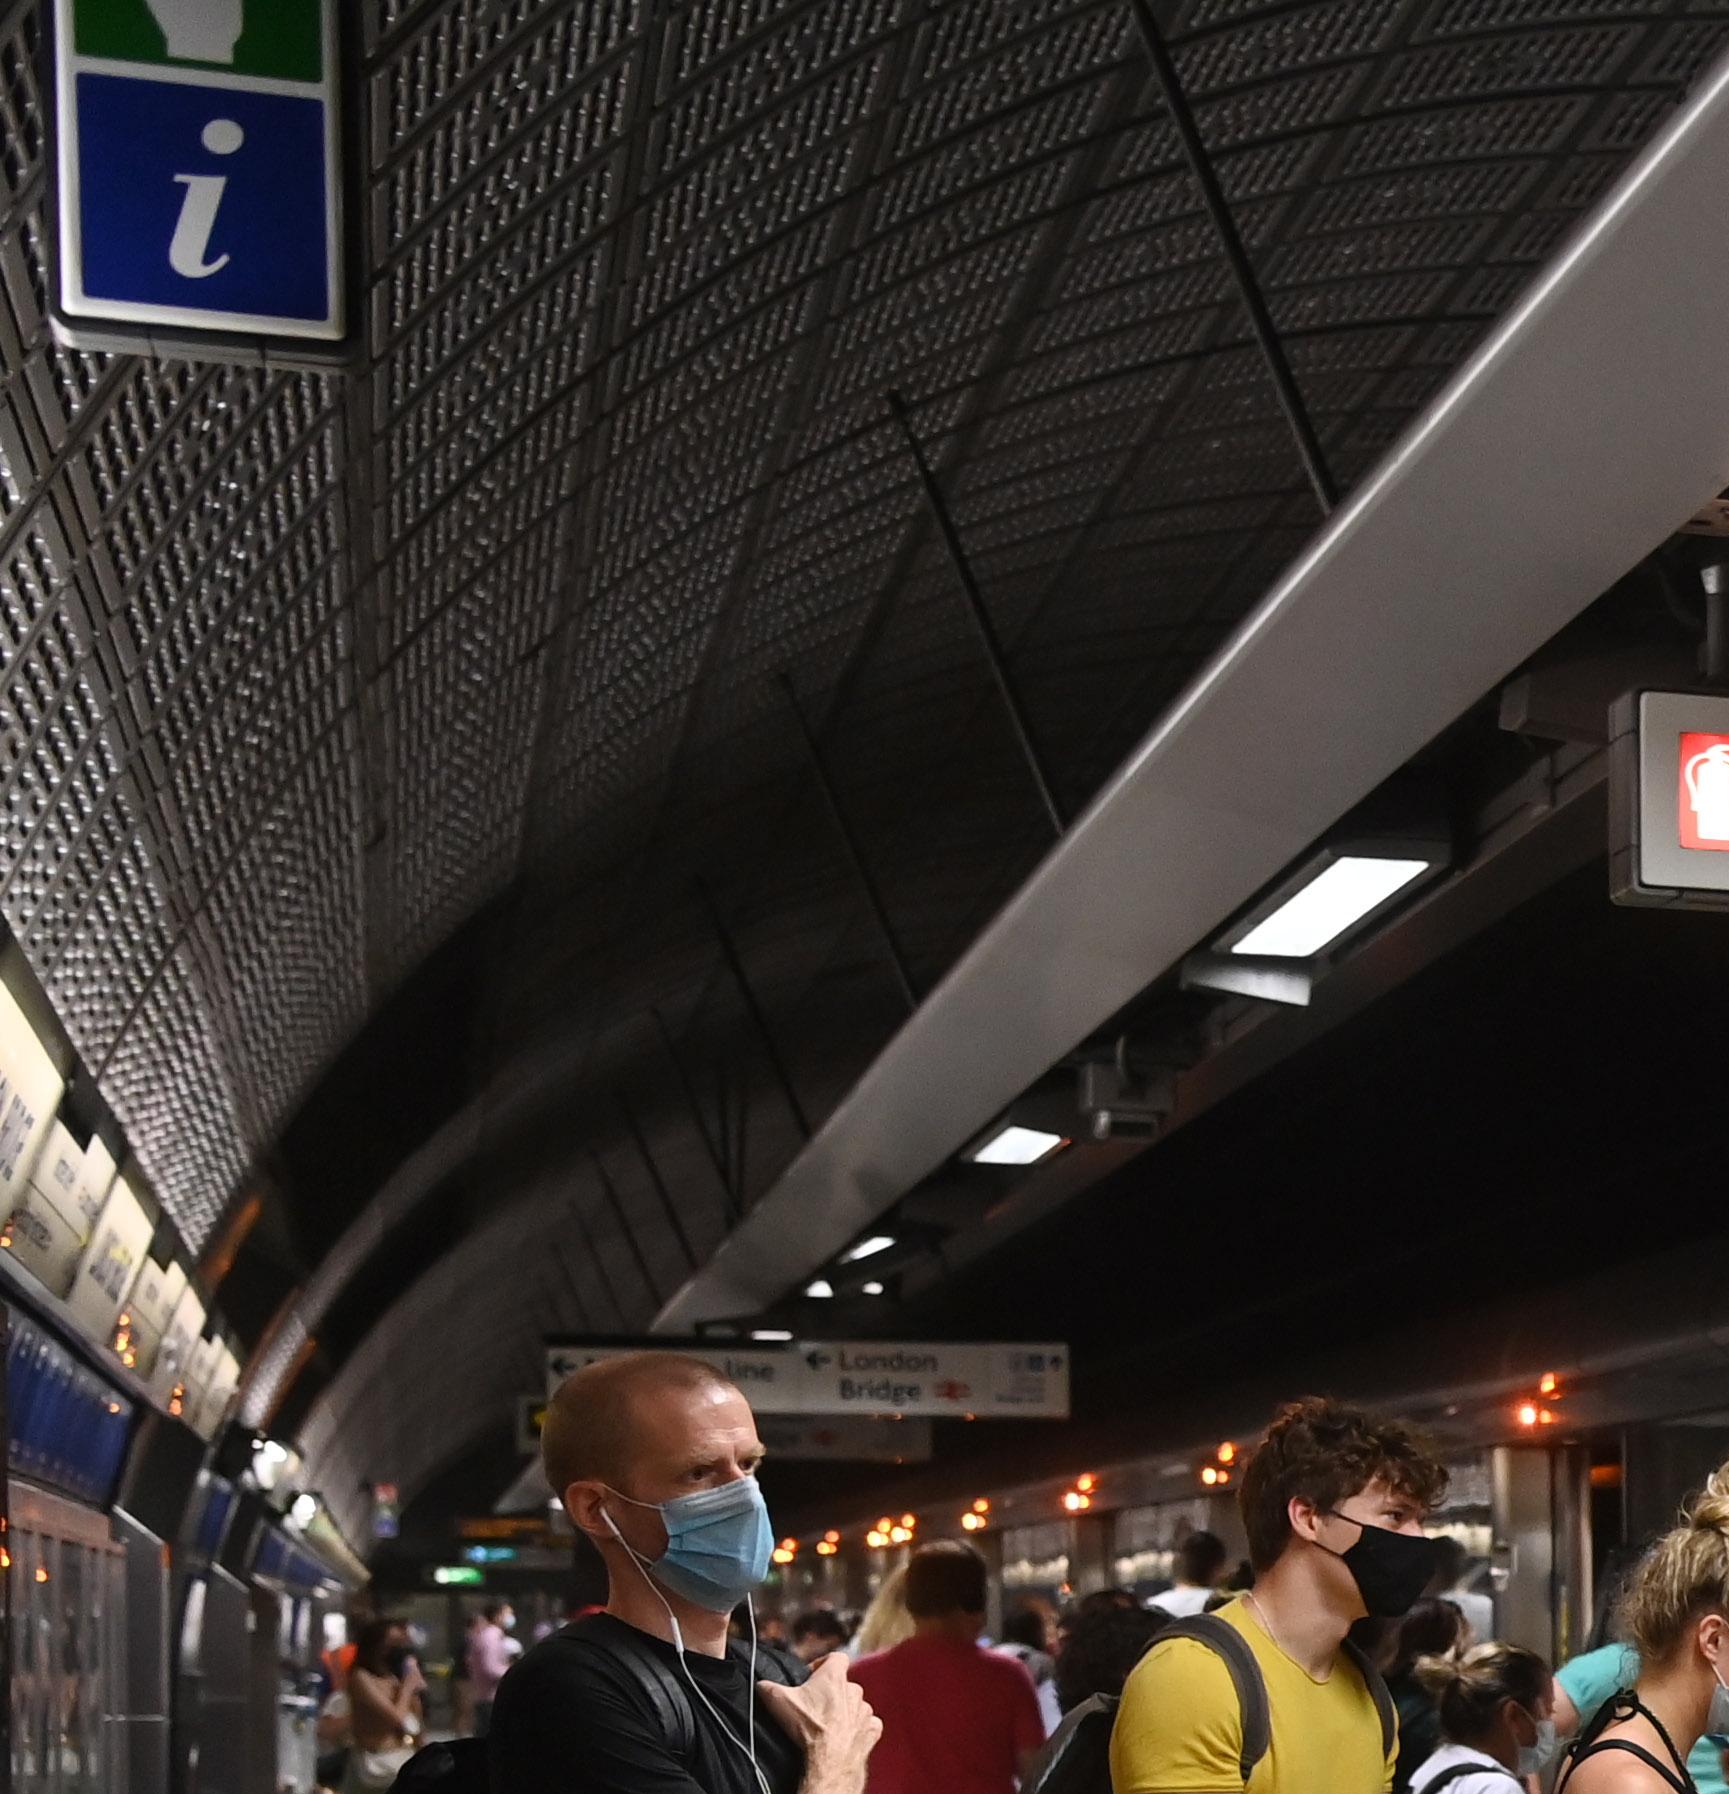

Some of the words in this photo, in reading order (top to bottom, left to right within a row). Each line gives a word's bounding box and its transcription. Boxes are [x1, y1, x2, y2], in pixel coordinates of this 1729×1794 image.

[725, 1360, 776, 1381] line
[840, 1352, 938, 1371] London
[839, 1379, 921, 1405] Bridge
